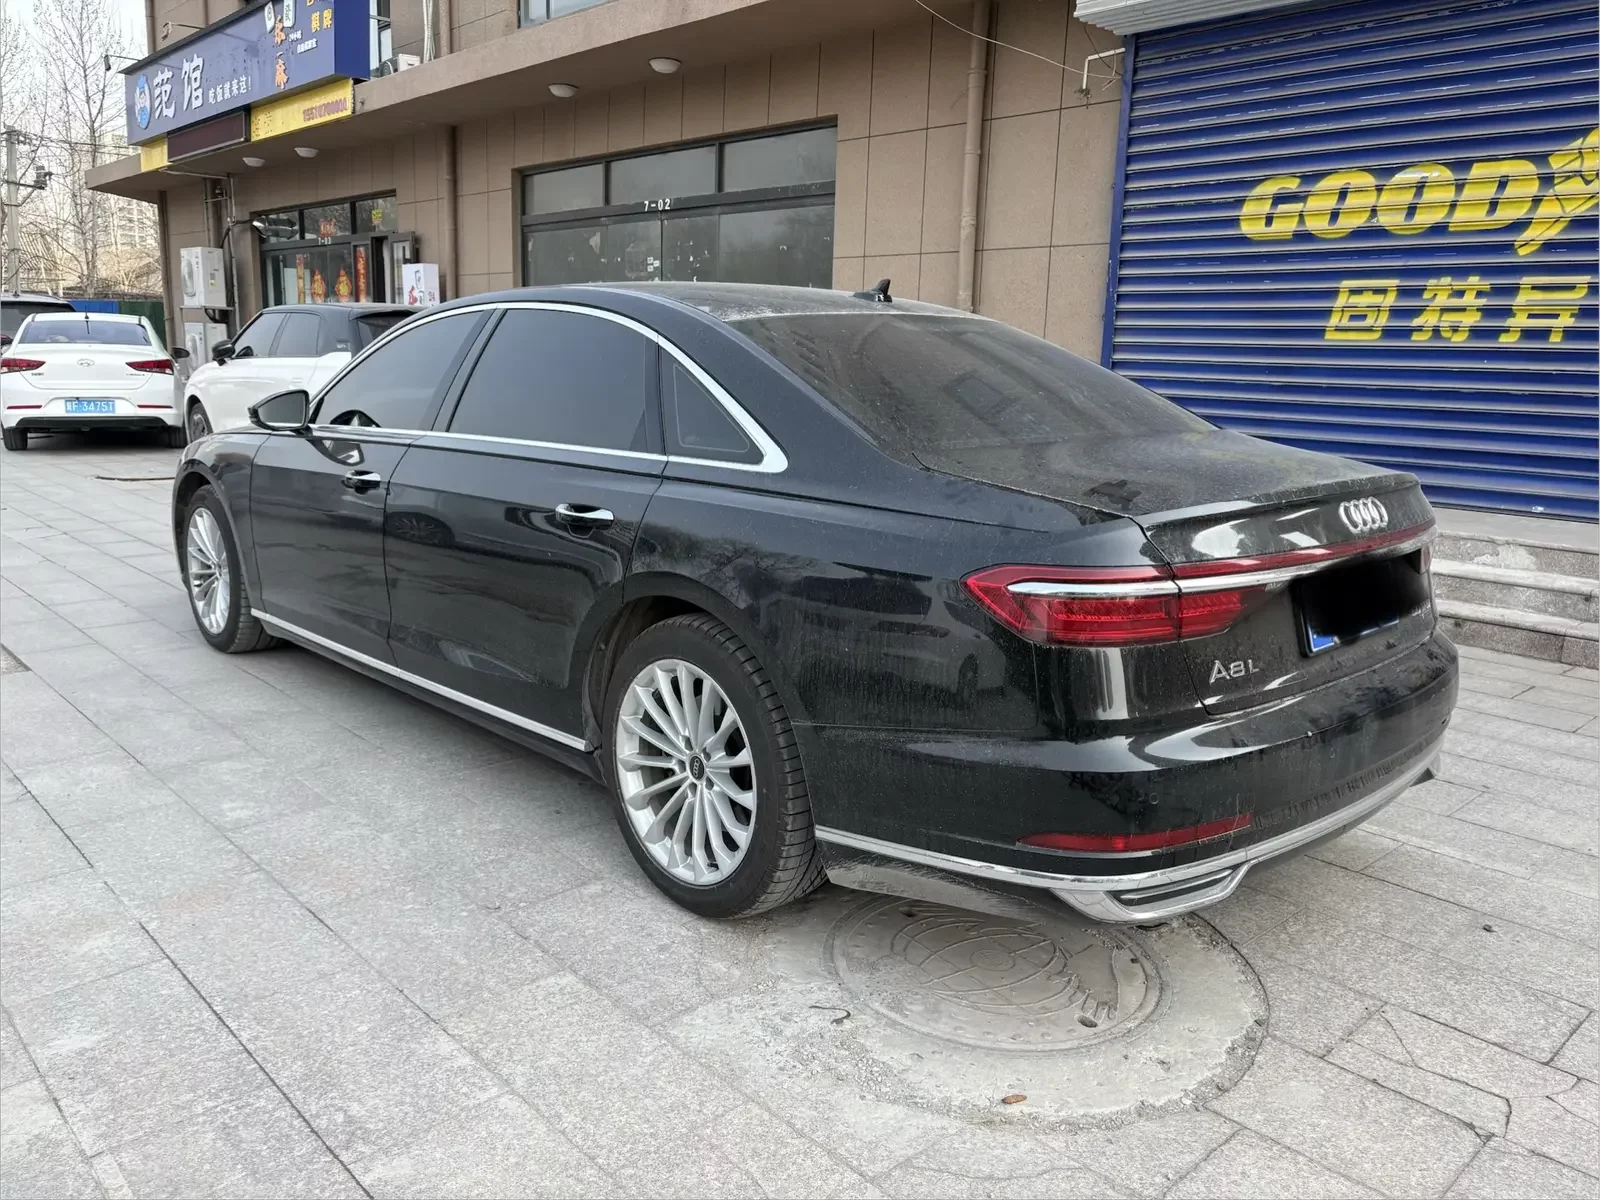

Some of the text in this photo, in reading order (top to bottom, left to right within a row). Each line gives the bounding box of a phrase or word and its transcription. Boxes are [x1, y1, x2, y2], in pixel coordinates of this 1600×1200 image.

[643, 198, 671, 212] 7-02
[1324, 275, 1592, 343] 固特异
